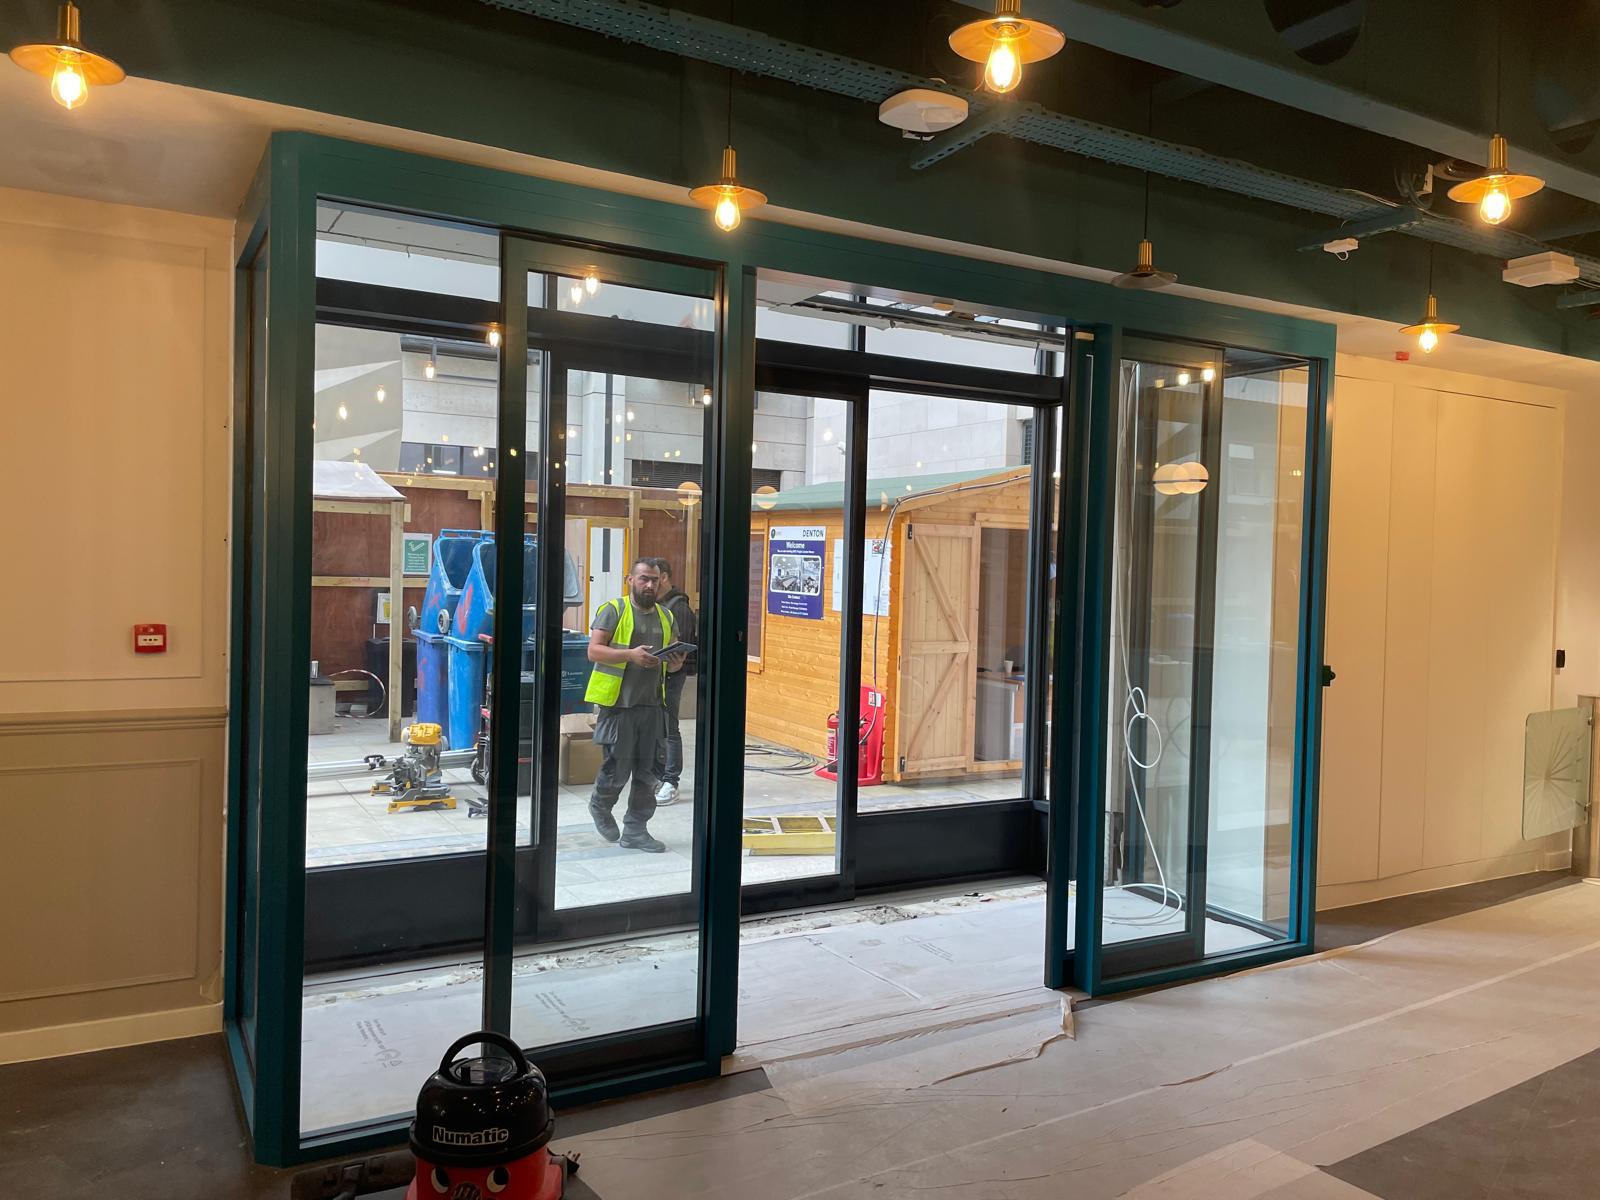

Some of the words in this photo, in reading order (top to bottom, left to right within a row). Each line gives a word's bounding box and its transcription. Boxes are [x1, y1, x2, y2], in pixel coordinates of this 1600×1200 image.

[802, 529, 824, 538] DENTON
[785, 541, 805, 549] Welcome
[432, 1125, 509, 1146] Numatic
